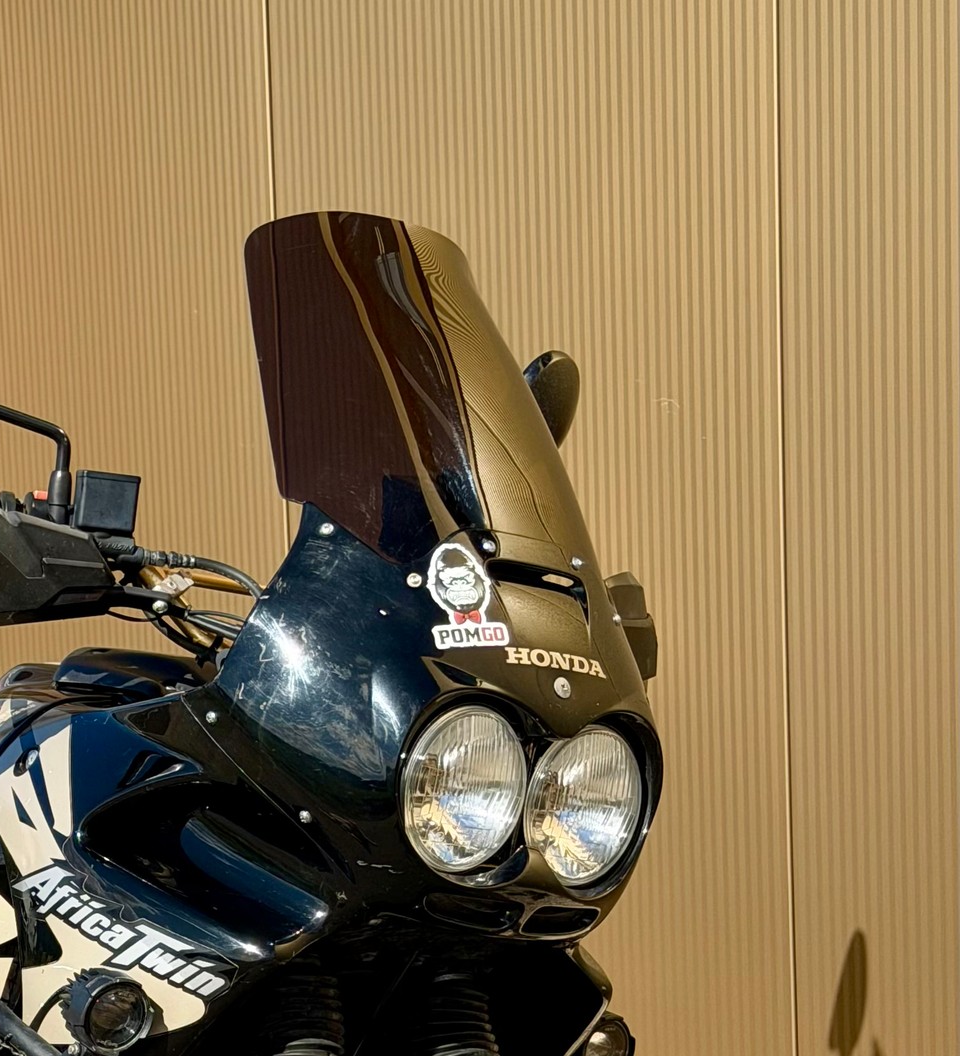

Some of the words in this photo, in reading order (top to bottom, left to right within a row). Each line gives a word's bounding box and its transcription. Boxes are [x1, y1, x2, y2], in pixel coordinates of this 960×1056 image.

[437, 626, 506, 645] POMGO
[504, 646, 607, 679] HONDA
[12, 864, 138, 951] Africa
[110, 922, 229, 998] Twin
